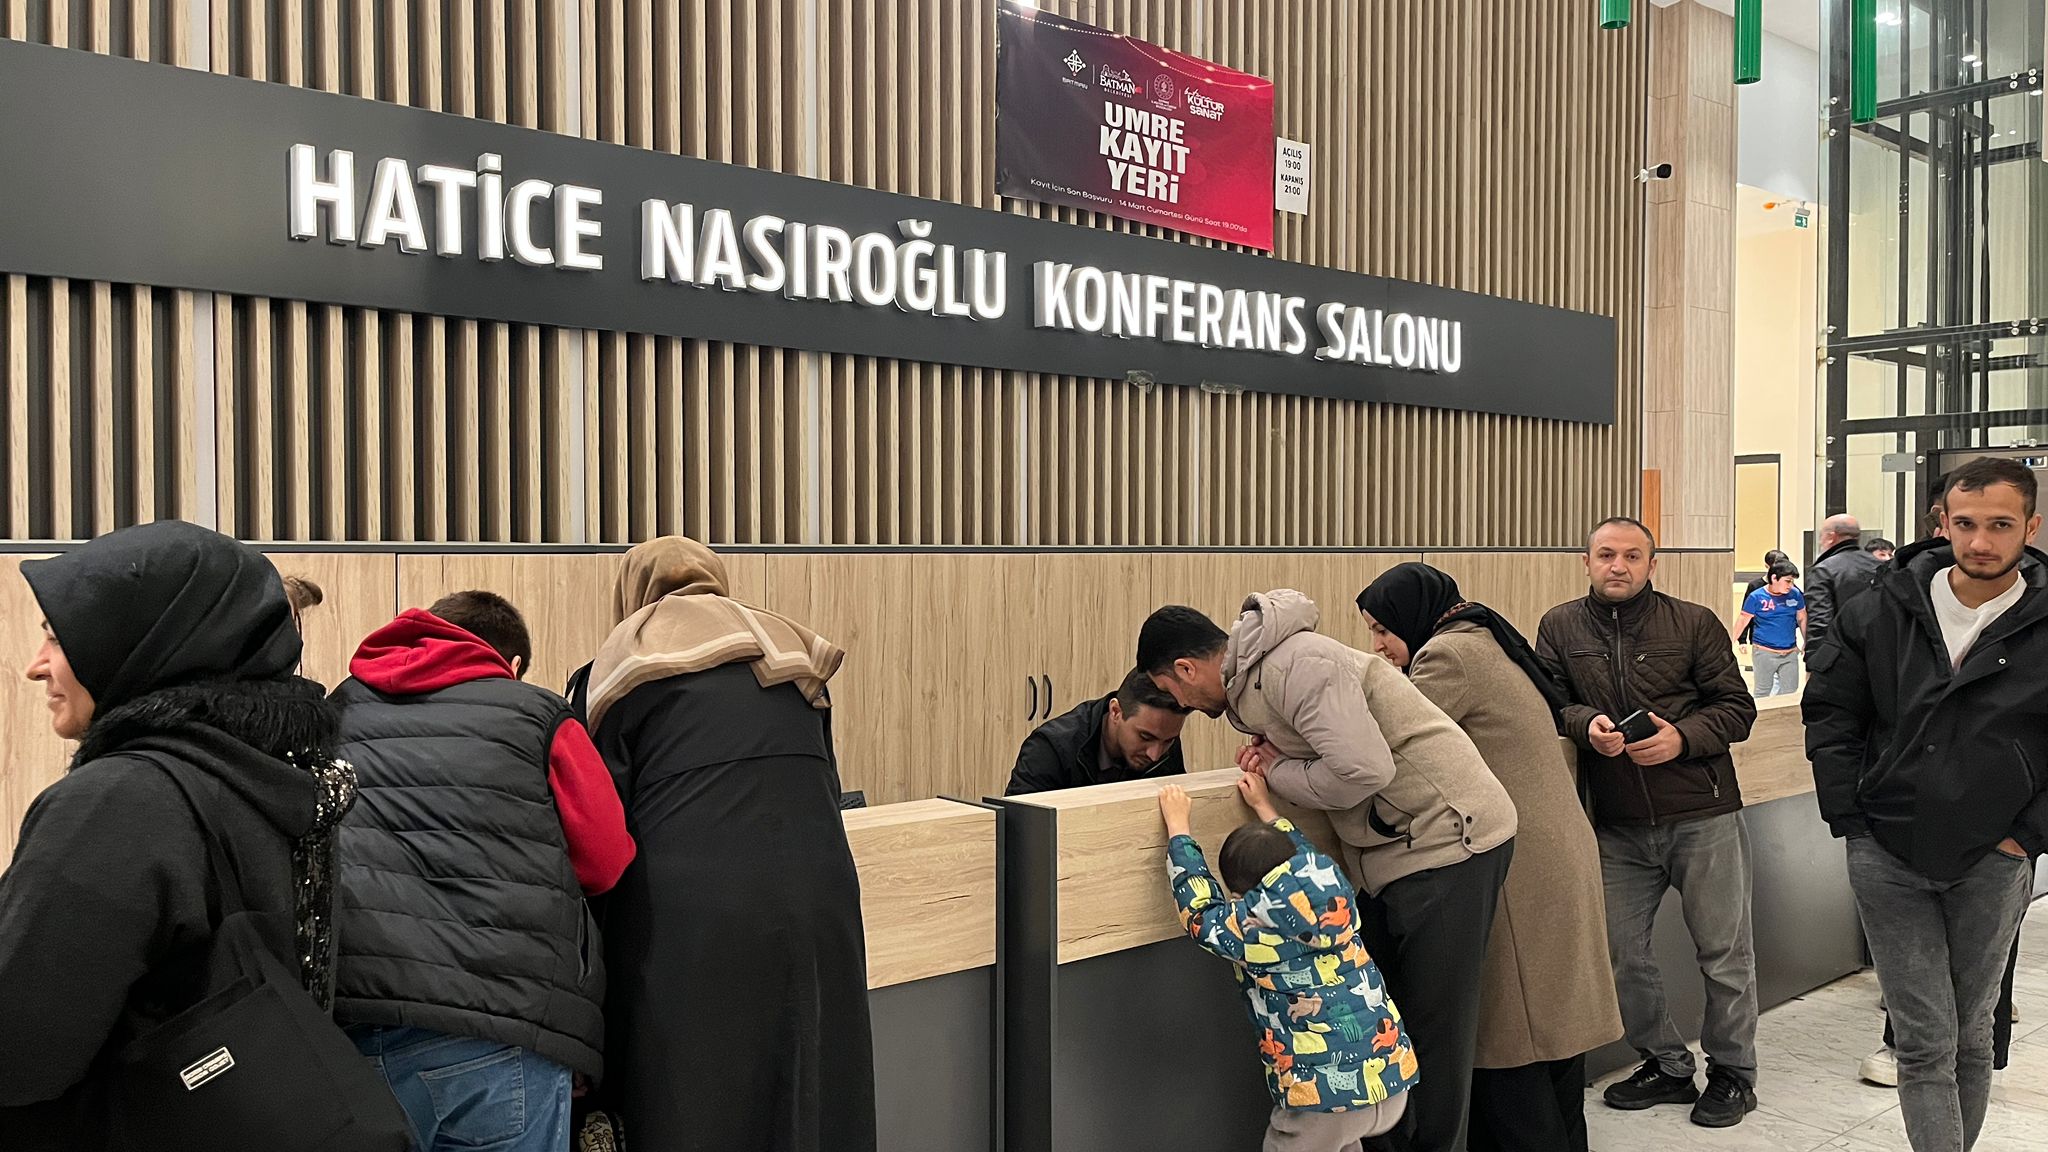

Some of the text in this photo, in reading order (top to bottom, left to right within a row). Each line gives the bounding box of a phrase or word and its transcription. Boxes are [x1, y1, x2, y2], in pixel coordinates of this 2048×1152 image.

[1100, 75, 1135, 94] BATMAN
[1104, 101, 1185, 145] UMRE
[1100, 125, 1190, 174] KAYIT
[1066, 187, 1081, 197] Son
[1119, 200, 1127, 208] 14
[1128, 201, 1146, 211] Mart
[1204, 218, 1221, 228] Saat
[289, 143, 1462, 374] HATİCE NASIROĞLU KONFERANS SALONU
[1760, 598, 1775, 611] 24
